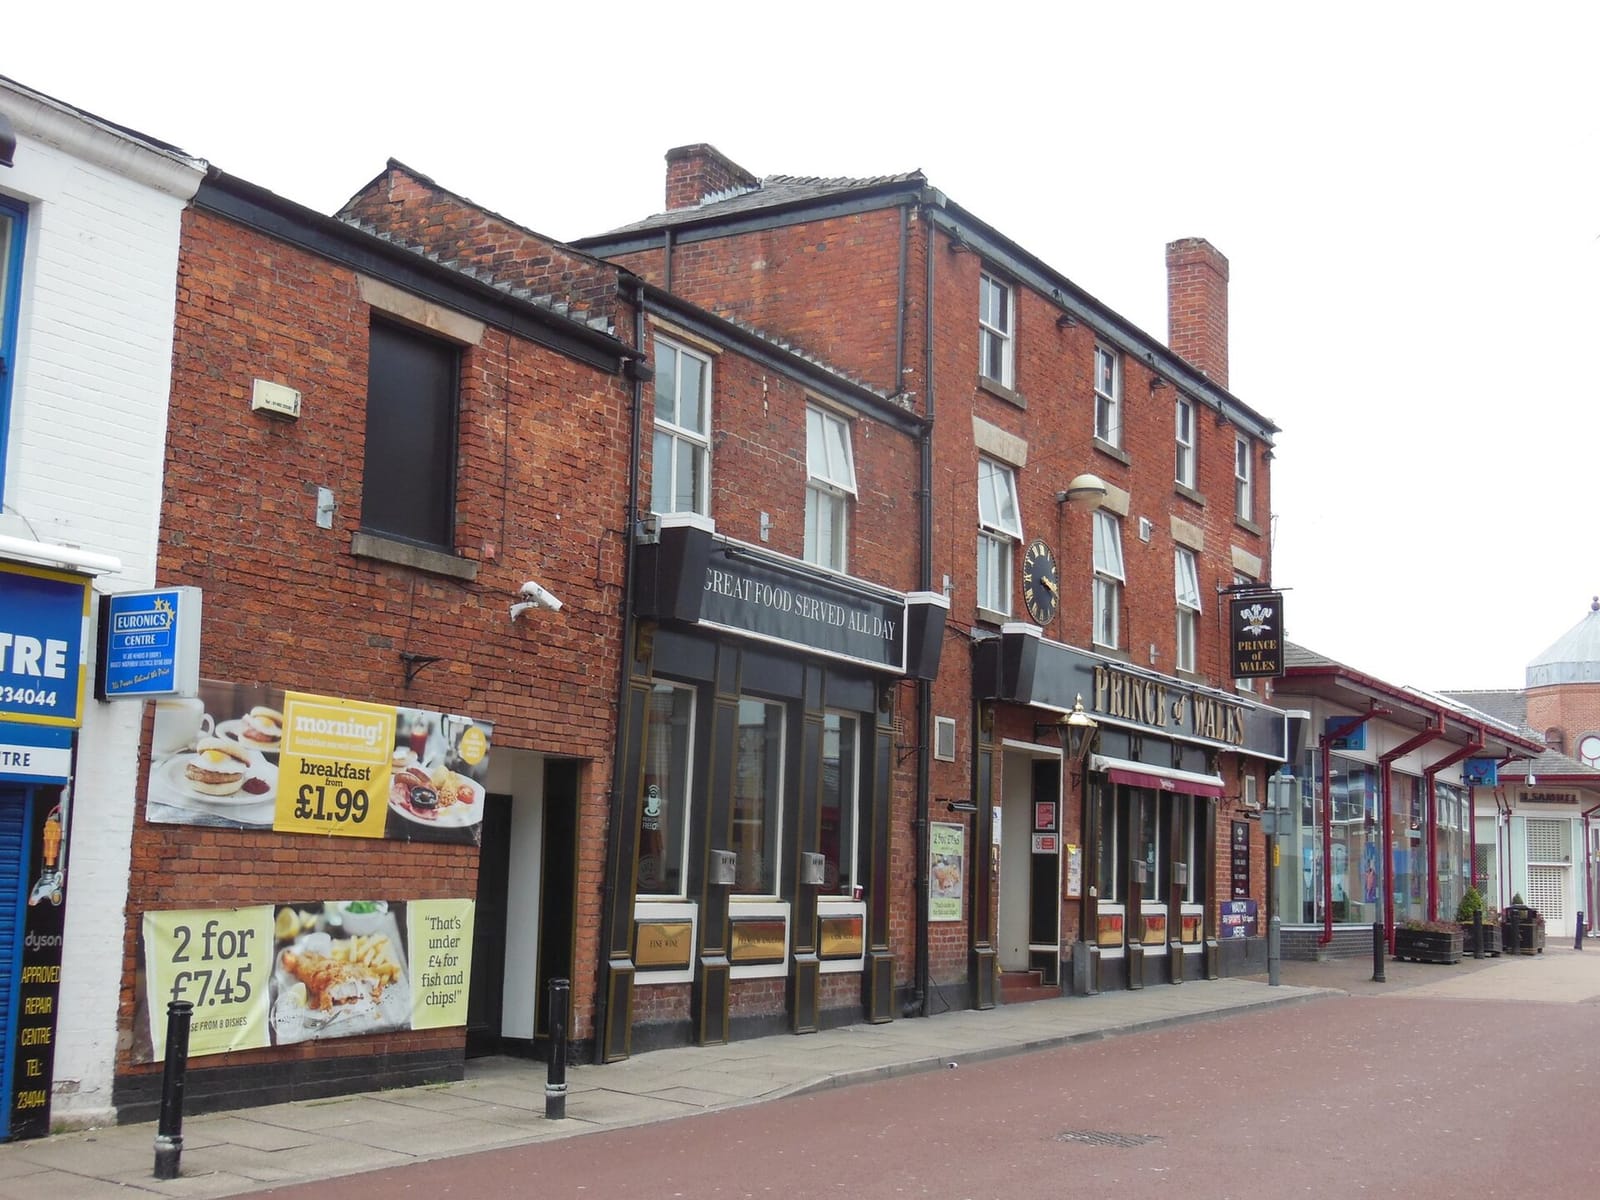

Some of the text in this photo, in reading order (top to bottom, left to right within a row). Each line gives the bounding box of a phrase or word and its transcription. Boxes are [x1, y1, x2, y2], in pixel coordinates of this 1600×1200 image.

[703, 567, 896, 641] GREAT FOOD SERVED ALL DAY
[117, 613, 166, 629] EURONICS
[124, 634, 156, 646] CENTRE
[1237, 639, 1277, 651] PRINCE
[1251, 651, 1263, 661] of
[1239, 660, 1276, 672] WALES
[1093, 665, 1244, 746] PRINCE of WALES
[295, 716, 384, 746] morning!
[300, 758, 371, 781] breakfast
[325, 777, 343, 787] from
[294, 784, 369, 823] £1.99
[25, 930, 62, 951] dyson
[172, 920, 255, 963] 2 for
[428, 934, 461, 949] under
[428, 953, 459, 968] £4 for
[20, 965, 61, 983] APPROVED
[421, 970, 463, 987] fish and
[170, 963, 252, 1007] £7.45
[25, 996, 52, 1015] REPAIR
[200, 1020, 218, 1031] FROM
[225, 1016, 248, 1029] DISHES
[21, 1026, 52, 1046] CENTRE
[17, 1089, 46, 1109] 234044
